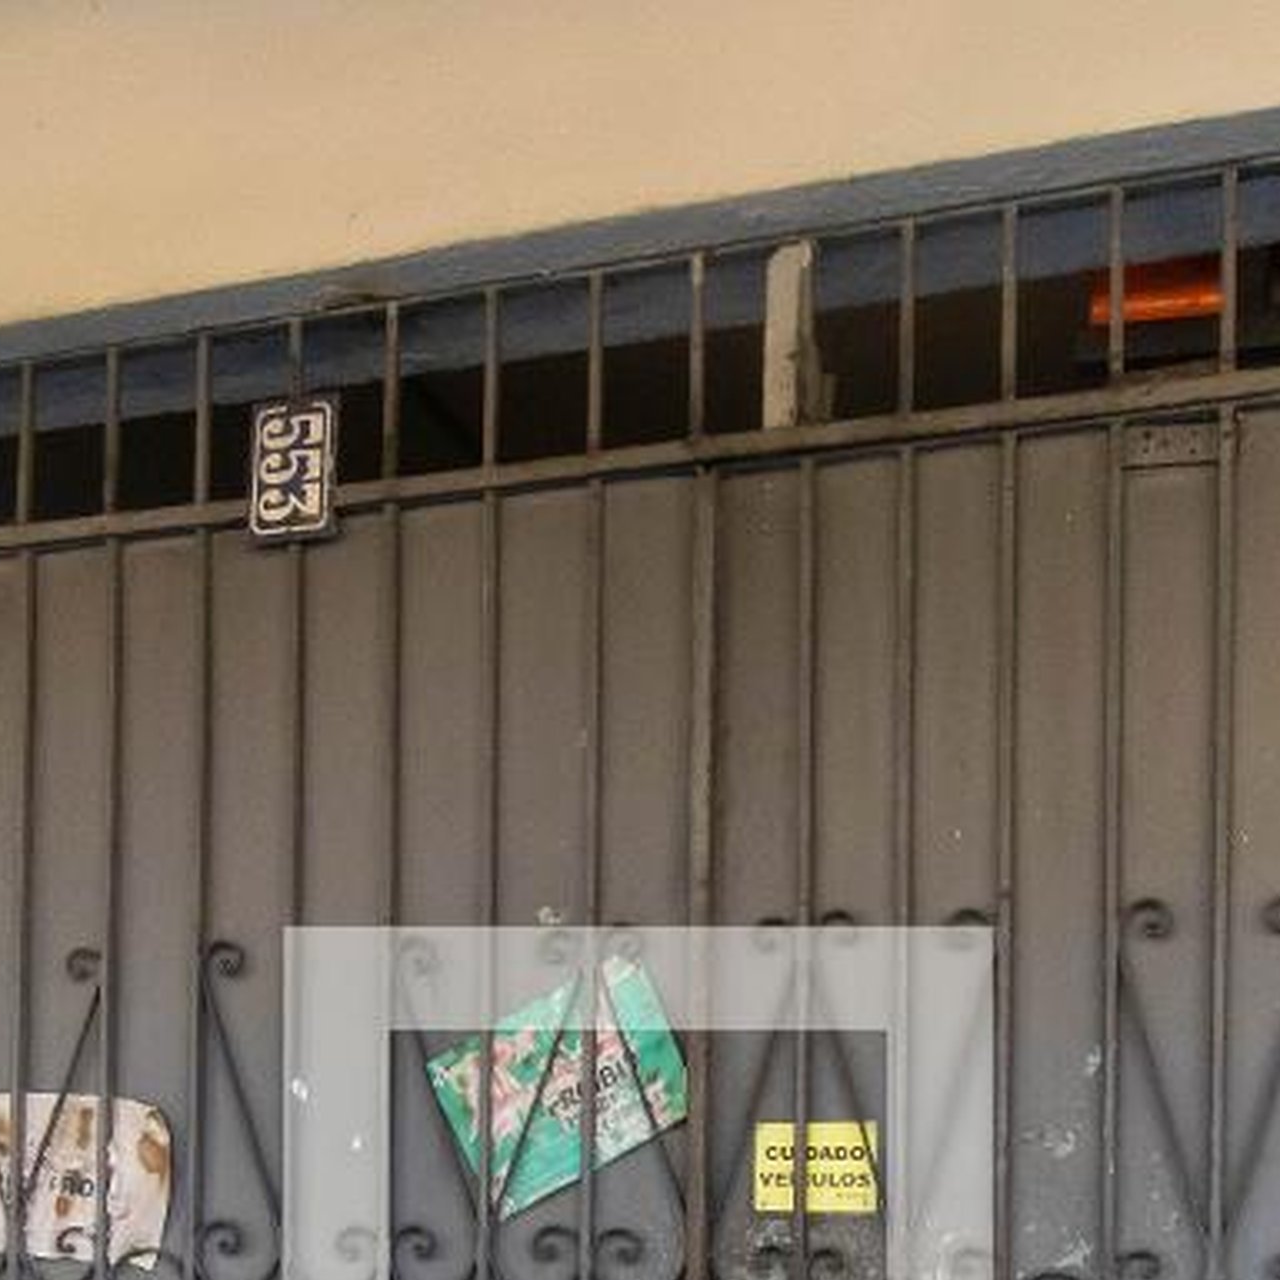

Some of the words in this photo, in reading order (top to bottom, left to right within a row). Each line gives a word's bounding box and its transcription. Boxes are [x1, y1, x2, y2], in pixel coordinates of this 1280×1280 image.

[259, 412, 324, 522] 553
[765, 1145, 866, 1162] CUDADO
[758, 1172, 872, 1188] VEULOS
